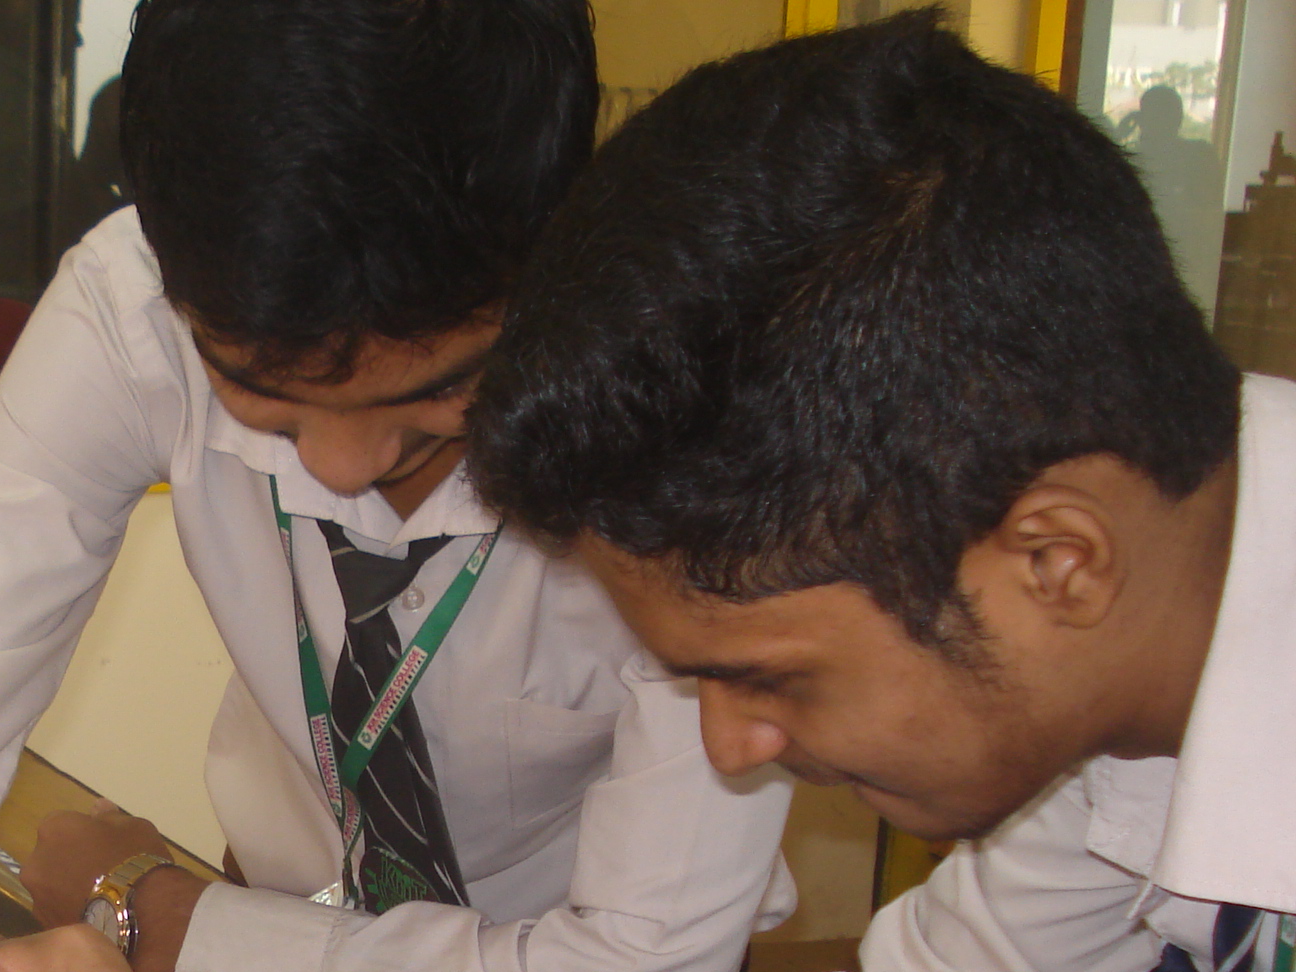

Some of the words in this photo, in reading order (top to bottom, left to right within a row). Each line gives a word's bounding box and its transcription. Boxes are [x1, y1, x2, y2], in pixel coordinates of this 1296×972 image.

[373, 685, 397, 719] SCIENCE
[393, 649, 421, 688] COLLEGE
[389, 655, 426, 710] RESIDENTIAL
[311, 719, 326, 756] COLLEGE
